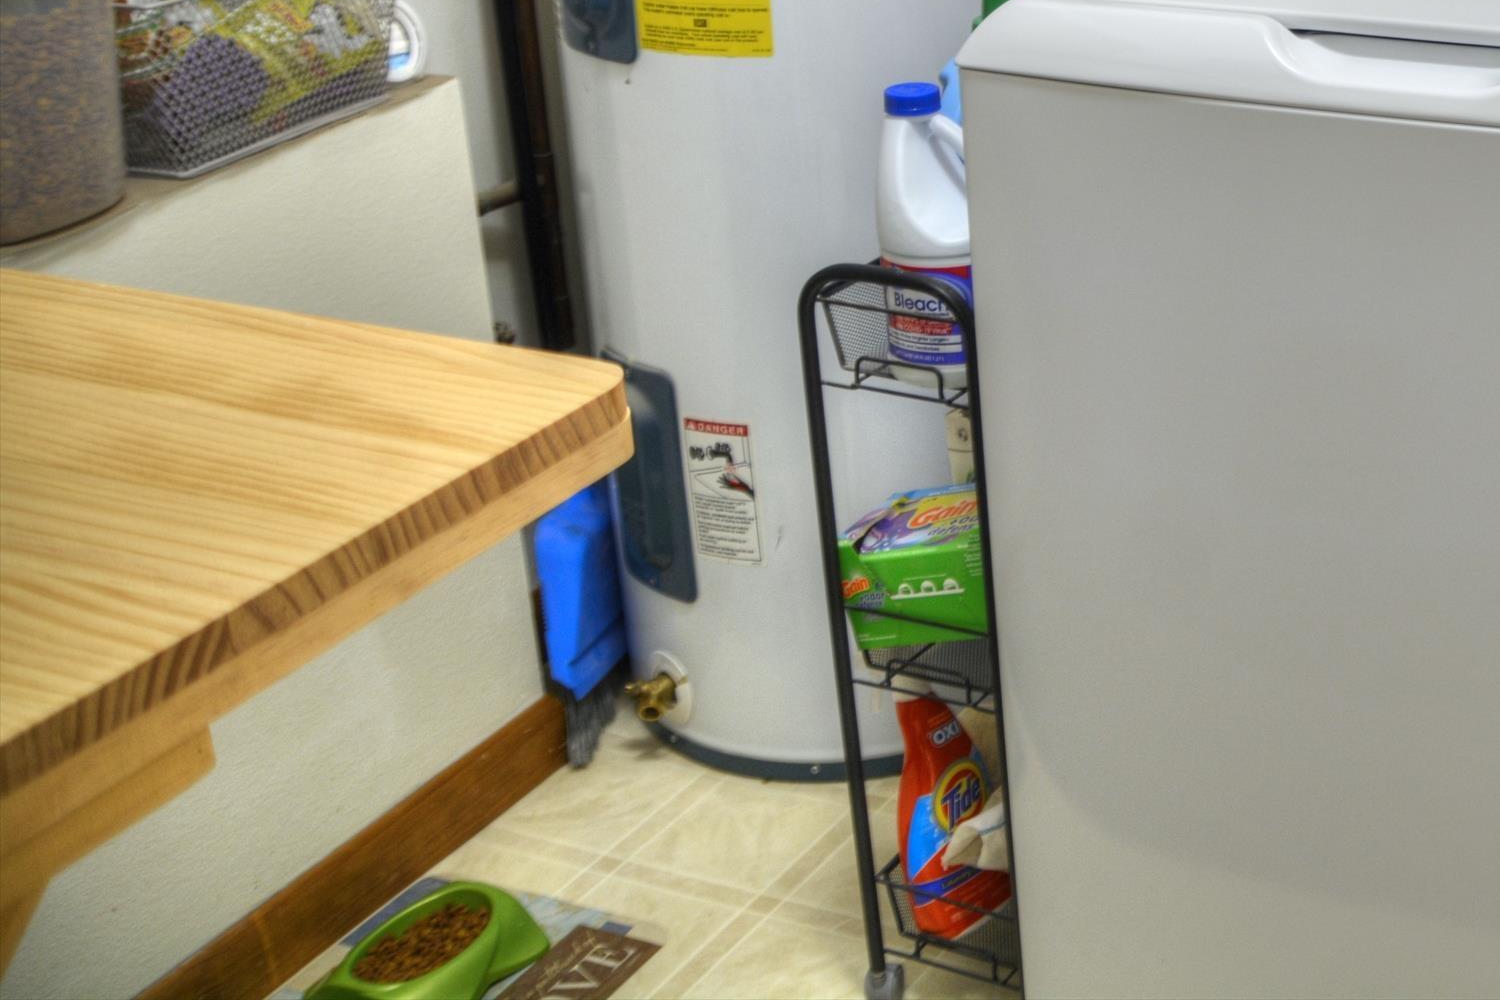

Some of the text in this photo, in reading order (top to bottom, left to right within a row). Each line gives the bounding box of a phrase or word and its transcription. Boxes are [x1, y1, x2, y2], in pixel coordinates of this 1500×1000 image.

[698, 424, 744, 435] DANGER
[908, 500, 977, 528] Gain
[842, 579, 868, 598] Gain
[933, 721, 960, 744] OXI
[941, 774, 981, 832] Tide
